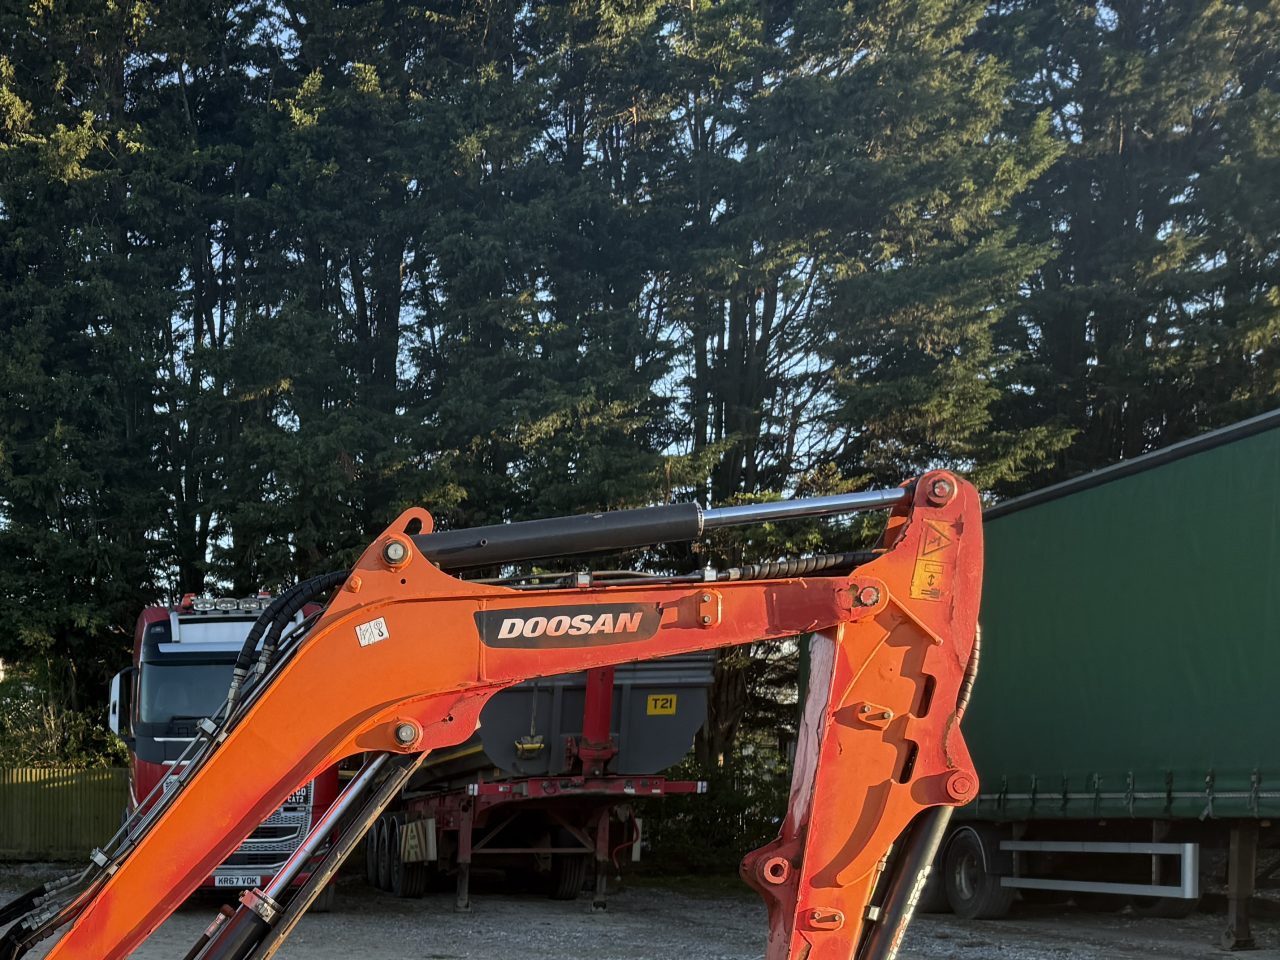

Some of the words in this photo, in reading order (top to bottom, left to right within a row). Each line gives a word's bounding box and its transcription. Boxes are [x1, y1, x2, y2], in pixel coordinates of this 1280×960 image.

[497, 612, 643, 639] DOOSAN
[651, 697, 673, 710] T21
[218, 876, 240, 885] KR67
[241, 876, 257, 885] VOK
